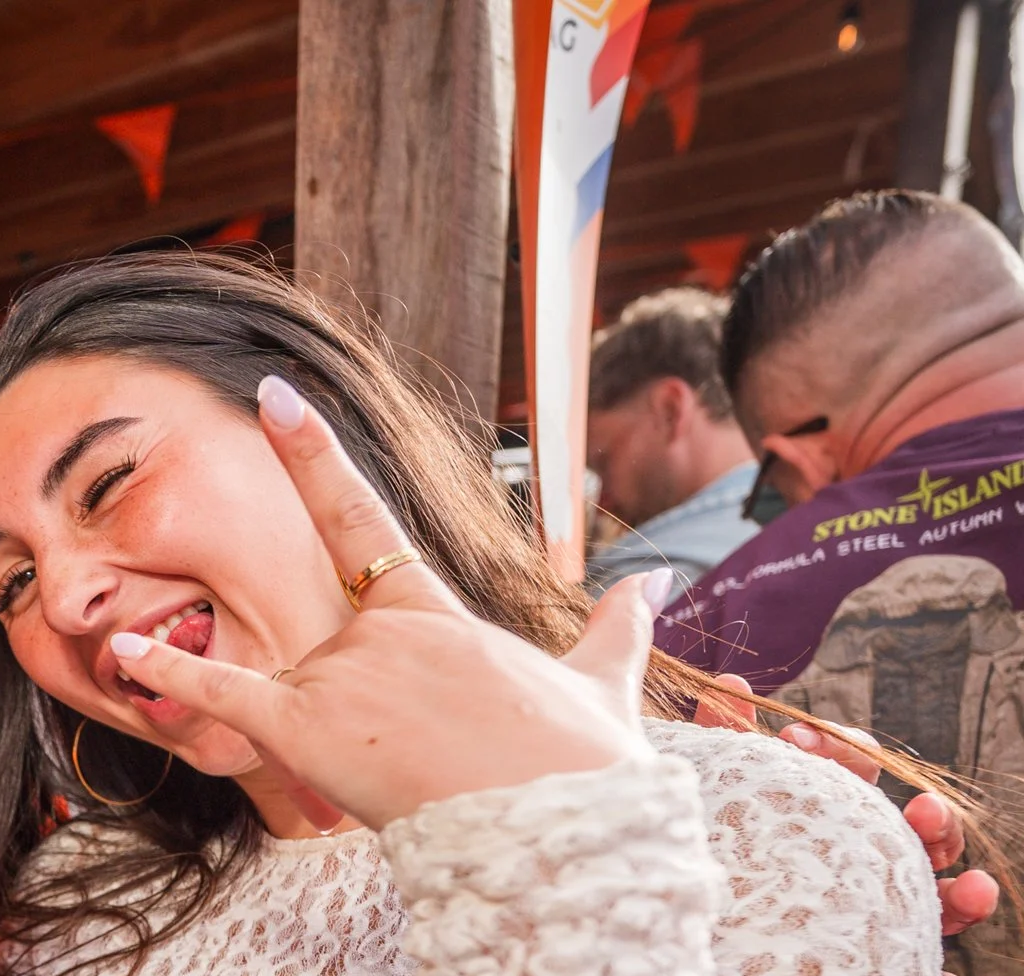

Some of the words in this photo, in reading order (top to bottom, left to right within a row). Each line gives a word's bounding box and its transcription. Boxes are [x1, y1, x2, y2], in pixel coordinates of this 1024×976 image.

[813, 504, 918, 543] STONE
[837, 533, 905, 557] STEEL
[919, 507, 1004, 546] AUTUMN
